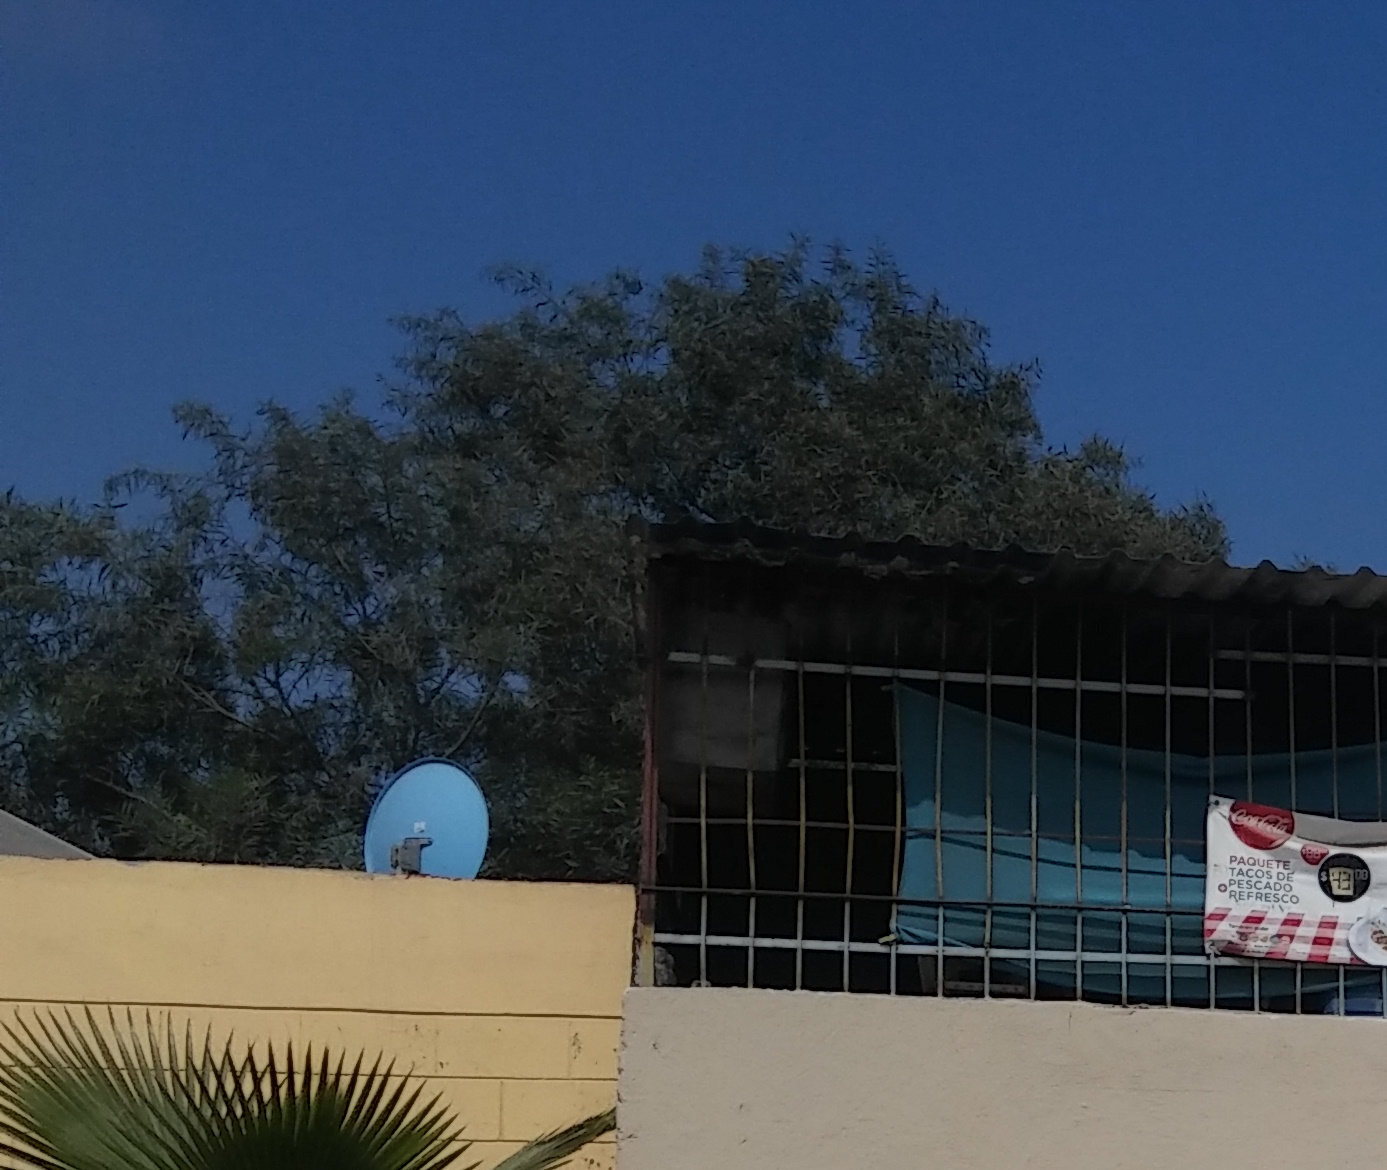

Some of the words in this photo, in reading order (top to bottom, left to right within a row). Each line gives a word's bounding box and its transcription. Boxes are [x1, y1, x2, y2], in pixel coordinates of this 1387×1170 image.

[1229, 855, 1291, 871] PAQUETE
[1228, 867, 1273, 880] TACOS
[1276, 871, 1294, 882] DE
[1228, 879, 1293, 893] PESCADO
[1228, 890, 1300, 904] REFRESCO
